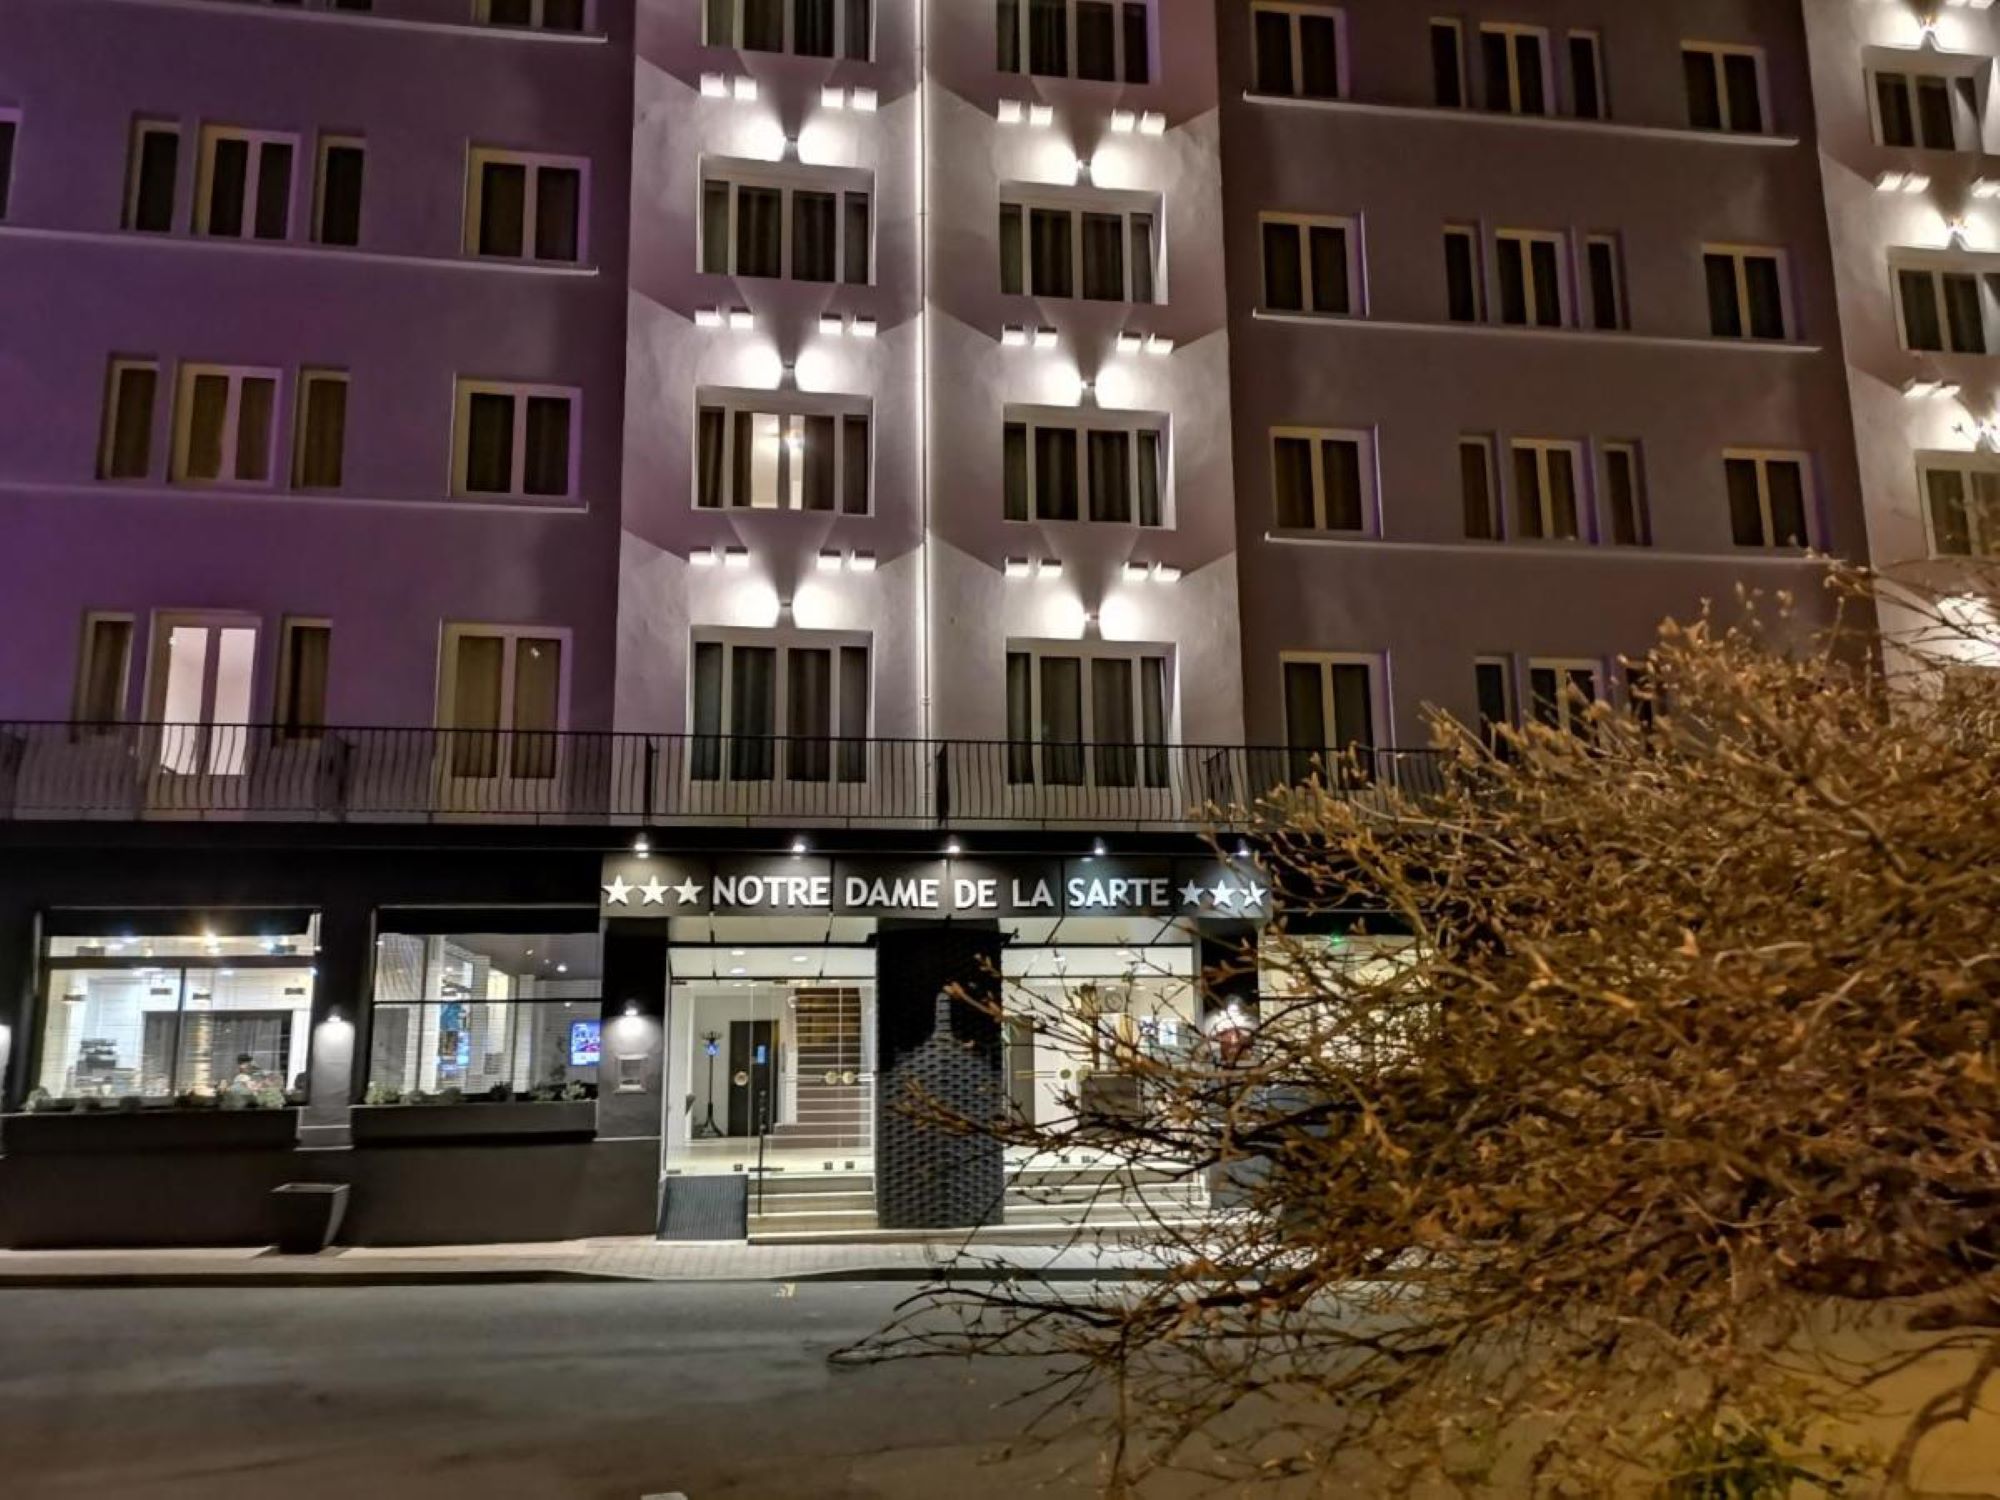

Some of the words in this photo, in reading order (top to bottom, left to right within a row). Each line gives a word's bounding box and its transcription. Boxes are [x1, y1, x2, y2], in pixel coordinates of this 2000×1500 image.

[712, 875, 831, 906] NOTRE
[845, 877, 940, 907] DAME
[954, 879, 997, 907] DE
[1012, 879, 1054, 907] LA
[1067, 878, 1170, 907] SARTE
